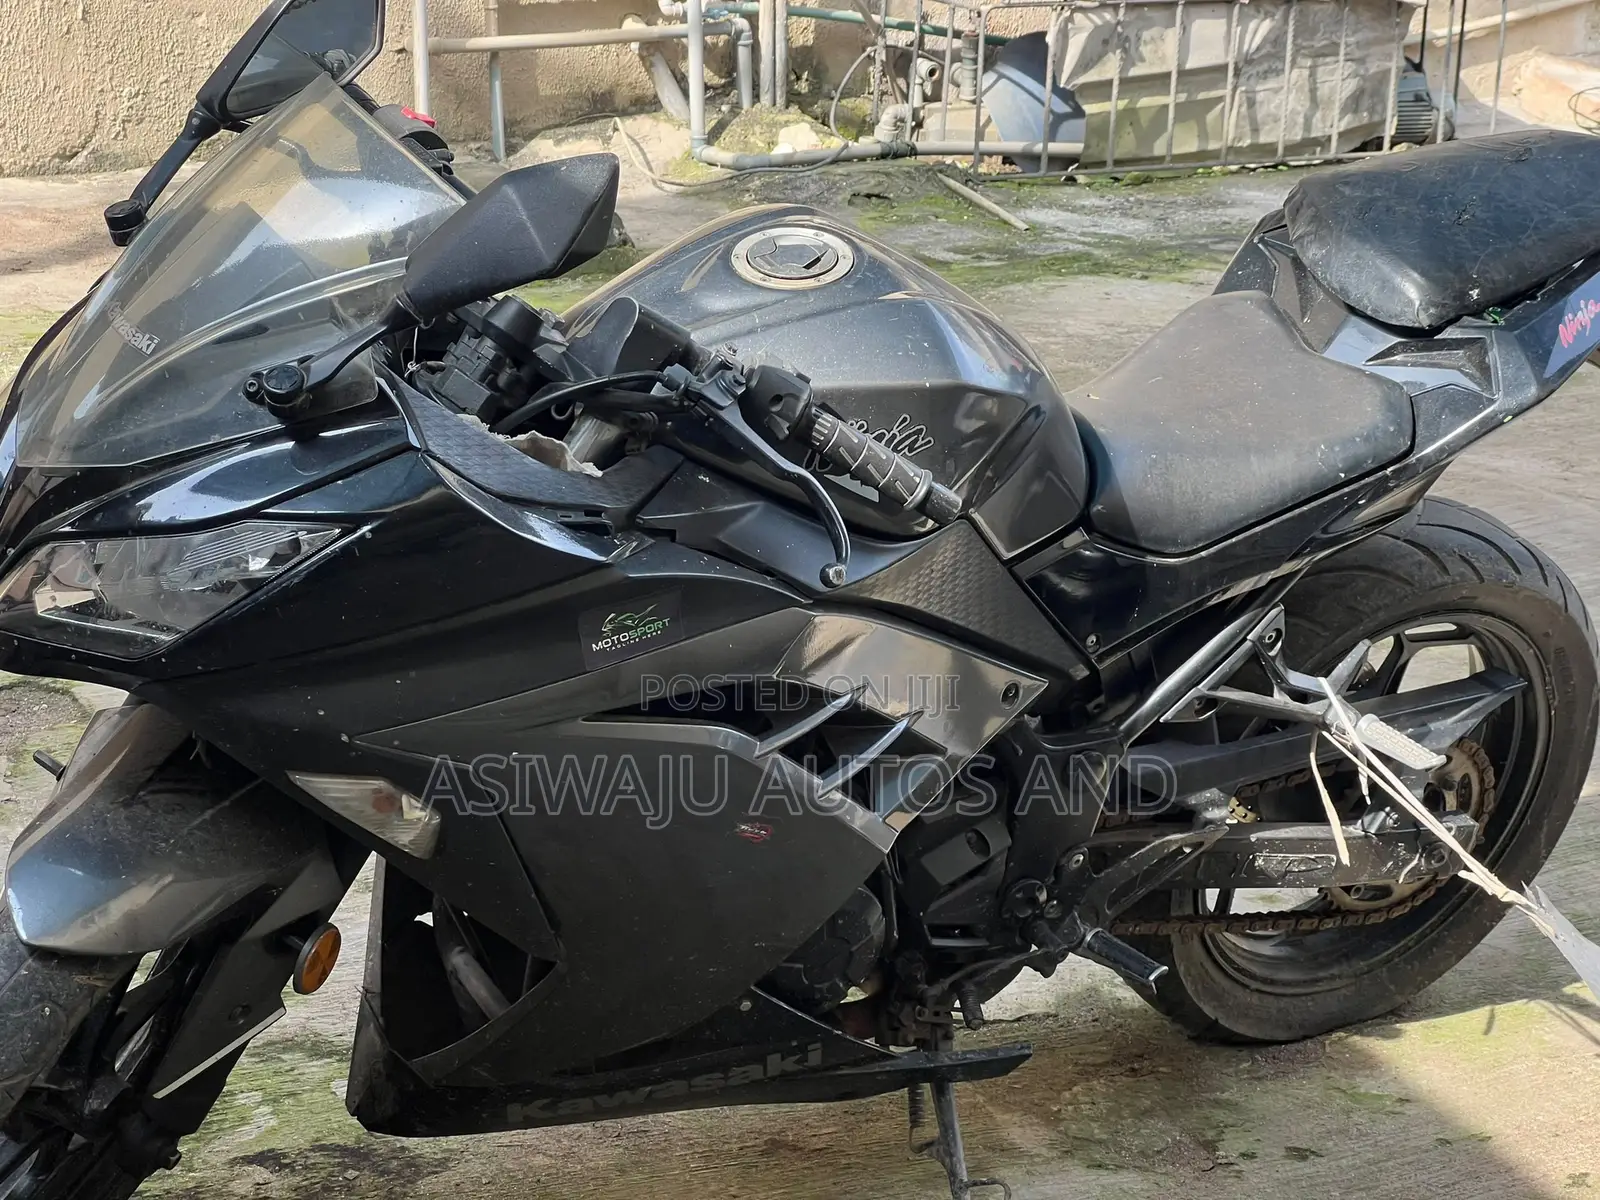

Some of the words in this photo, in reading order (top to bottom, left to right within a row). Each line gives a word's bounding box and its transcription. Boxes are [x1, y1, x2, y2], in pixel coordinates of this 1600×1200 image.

[1558, 299, 1600, 349] Ninja
[591, 618, 670, 652] MOTOSPORT
[606, 638, 639, 651] TAGLINE
[642, 631, 661, 639] HERE
[506, 1040, 823, 1123] Kawasaki
